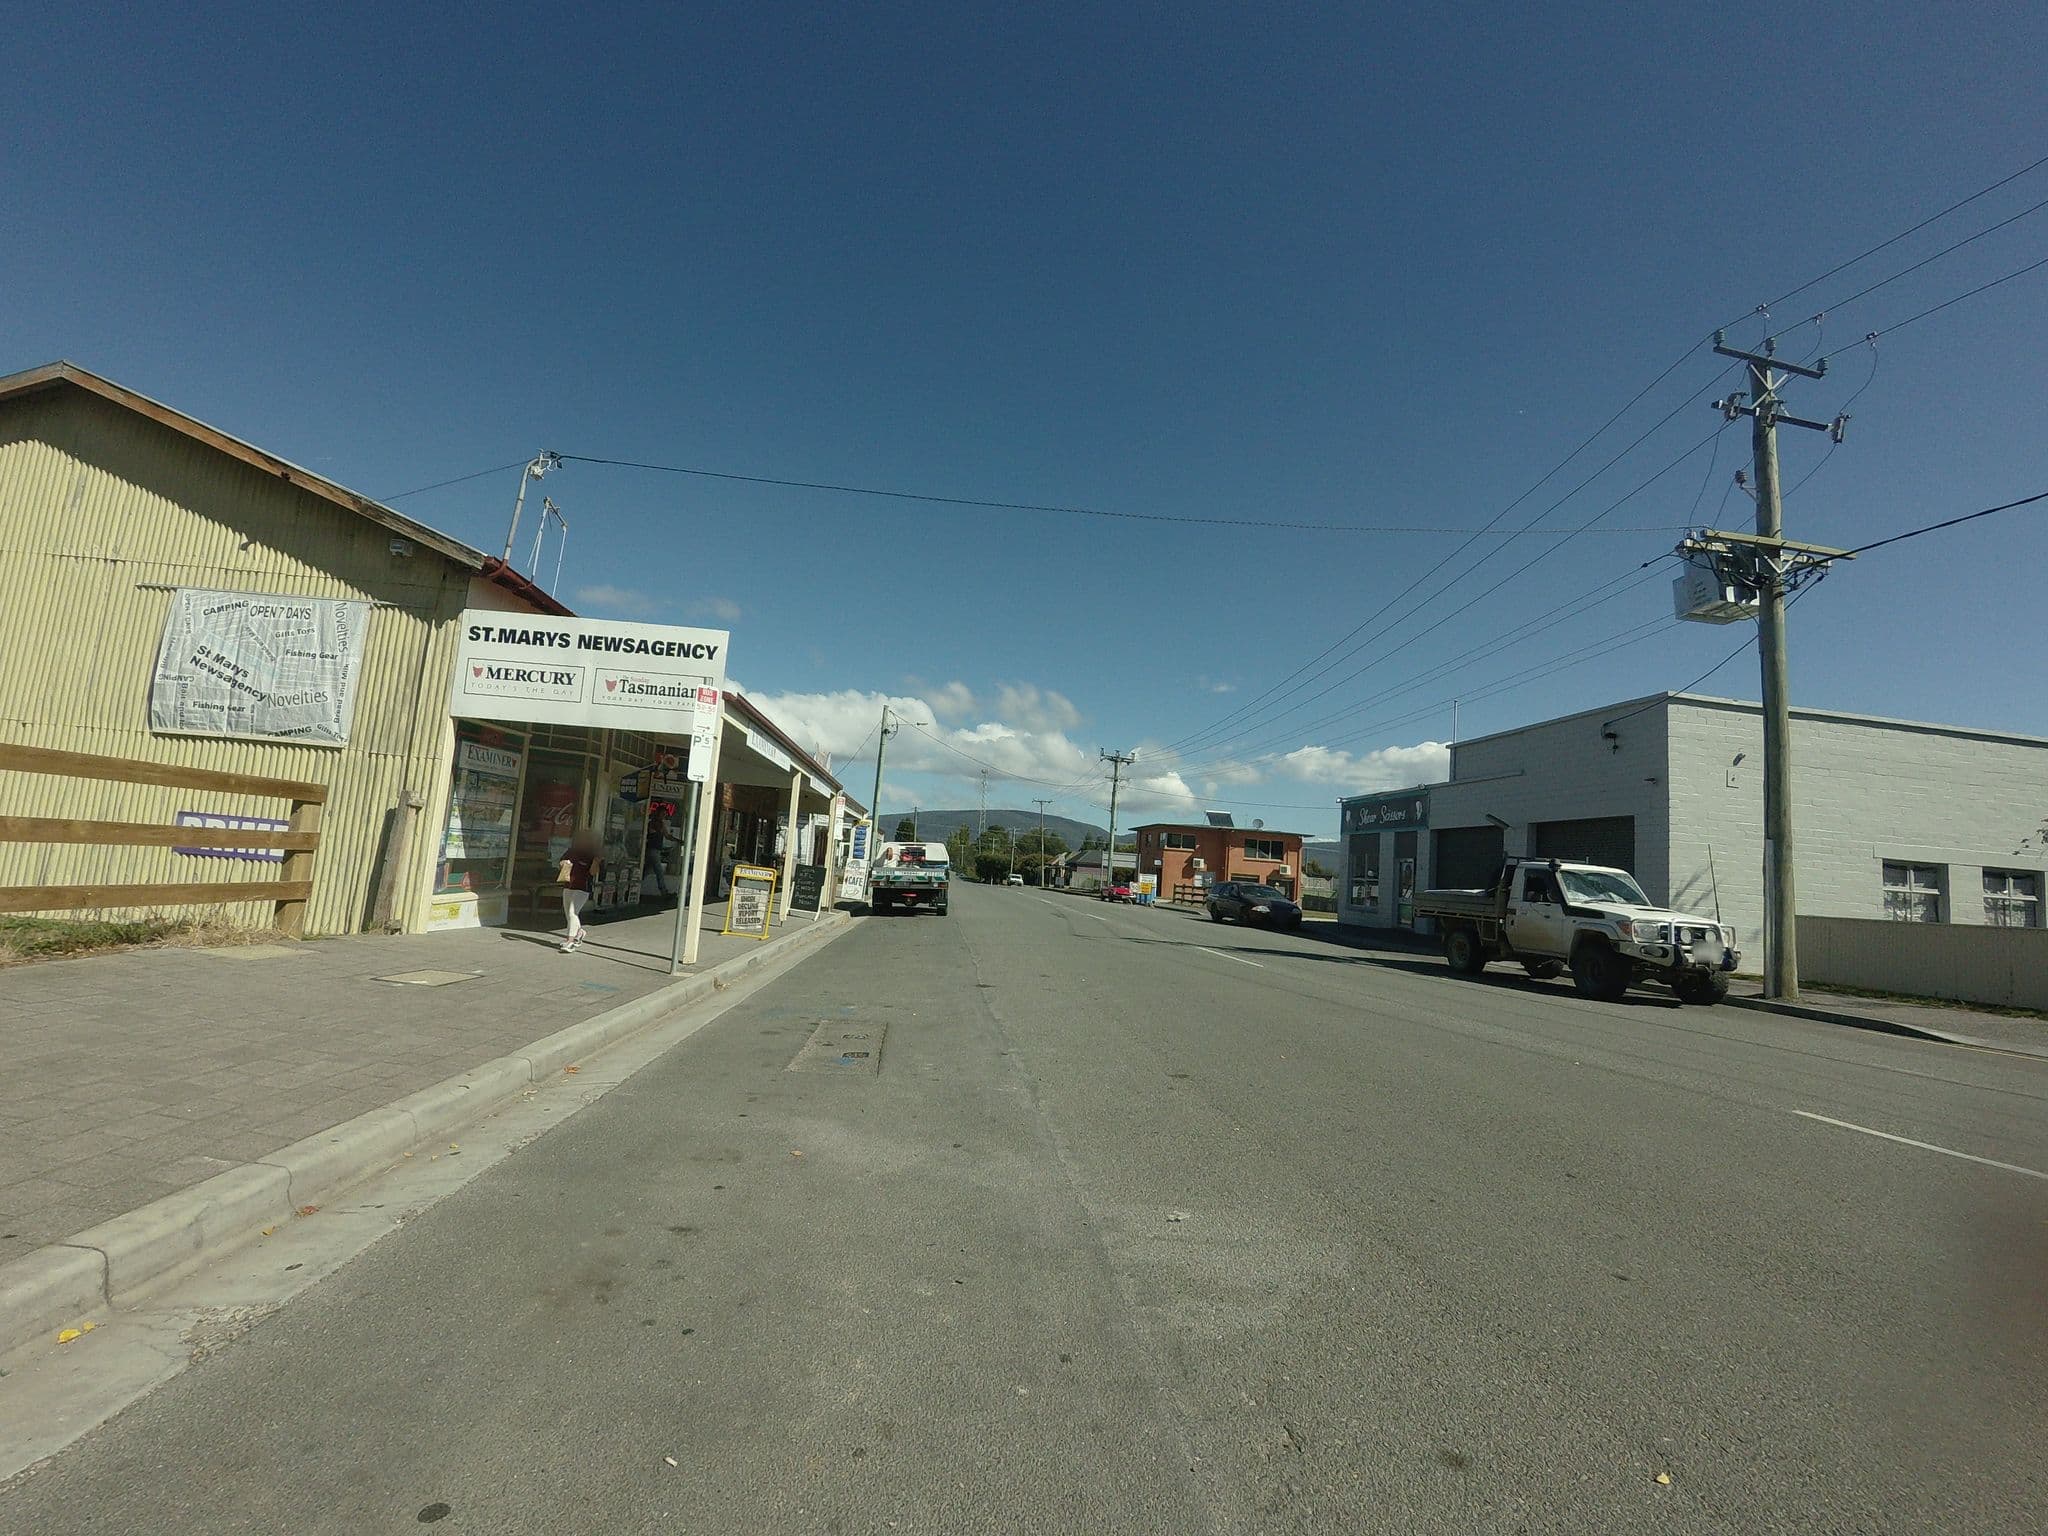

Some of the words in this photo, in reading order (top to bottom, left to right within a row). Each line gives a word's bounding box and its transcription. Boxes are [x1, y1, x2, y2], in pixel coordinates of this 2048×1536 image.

[203, 600, 249, 616] CAMPING
[250, 605, 276, 618] OPEN
[279, 607, 285, 619] 7
[286, 607, 312, 620] DAYS
[275, 630, 295, 638] Gifts
[335, 602, 348, 652] Novelties
[468, 625, 571, 649] ST.MARYS
[577, 634, 719, 661] NEWSAGENCY
[196, 645, 212, 658] St
[212, 653, 249, 679] Marys
[285, 649, 317, 660] Fishing
[319, 652, 338, 660] Gear
[189, 655, 268, 702] Newsagency
[486, 667, 576, 686] MERCURY
[192, 701, 225, 713] Fishing
[267, 689, 328, 709] Novelties
[333, 700, 343, 723] Bread
[468, 745, 512, 768] EXAMINER
[651, 783, 682, 793] UNDAY
